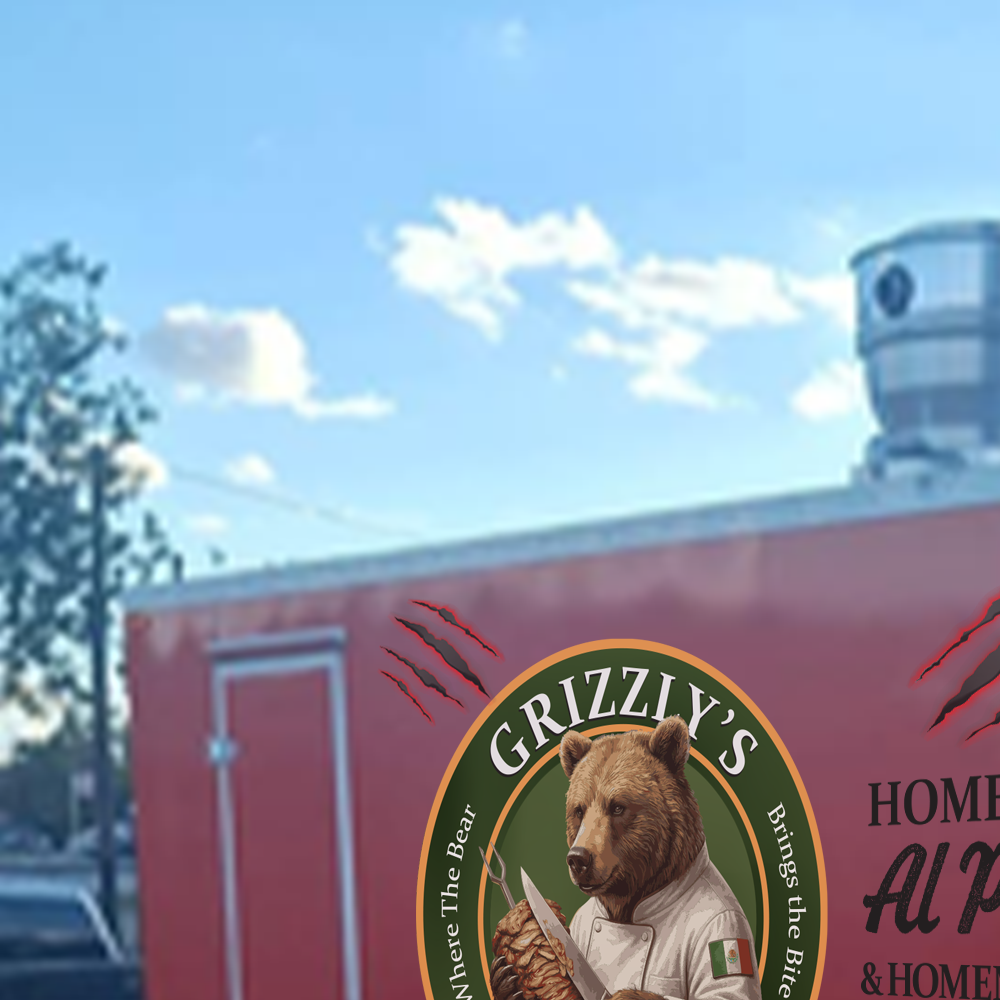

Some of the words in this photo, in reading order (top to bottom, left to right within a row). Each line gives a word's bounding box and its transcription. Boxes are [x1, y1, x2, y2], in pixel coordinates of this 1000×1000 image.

[446, 803, 477, 862] Bear
[766, 801, 799, 889] Brings
[440, 867, 461, 918] The
[862, 841, 951, 934] Al
[788, 894, 807, 940] the
[778, 946, 805, 999] Bite
